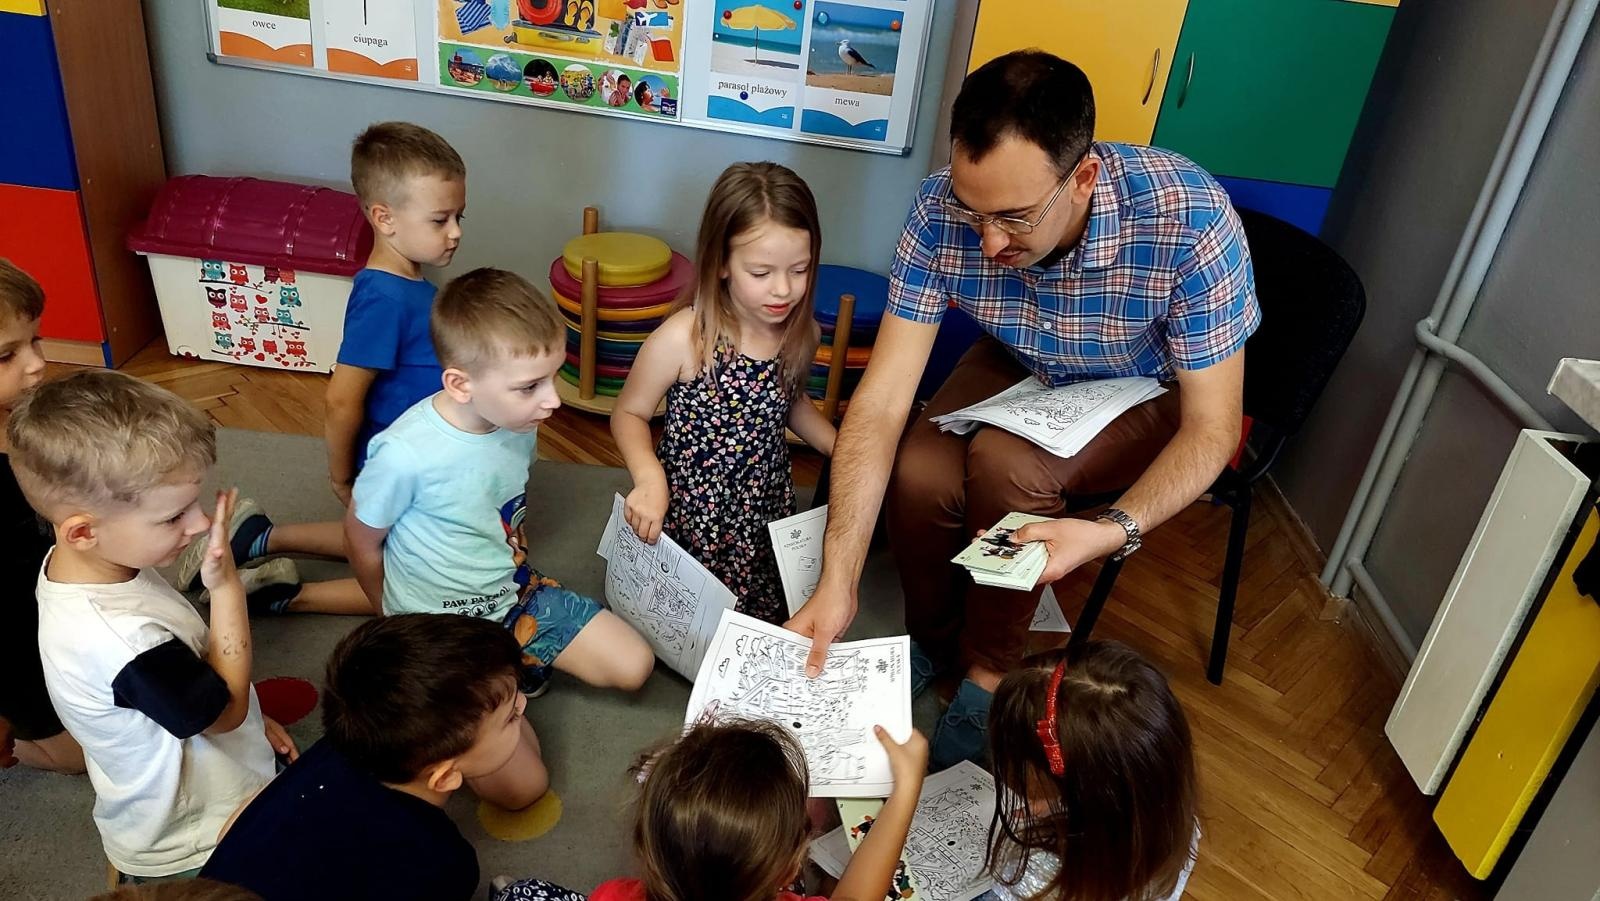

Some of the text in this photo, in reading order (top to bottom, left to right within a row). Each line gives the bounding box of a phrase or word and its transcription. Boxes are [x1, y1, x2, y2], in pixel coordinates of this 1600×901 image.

[252, 19, 277, 30] owce
[353, 33, 389, 48] ciupaga
[718, 81, 749, 92] parasol
[834, 97, 860, 107] mewa
[442, 585, 511, 609] PAW PATROL
